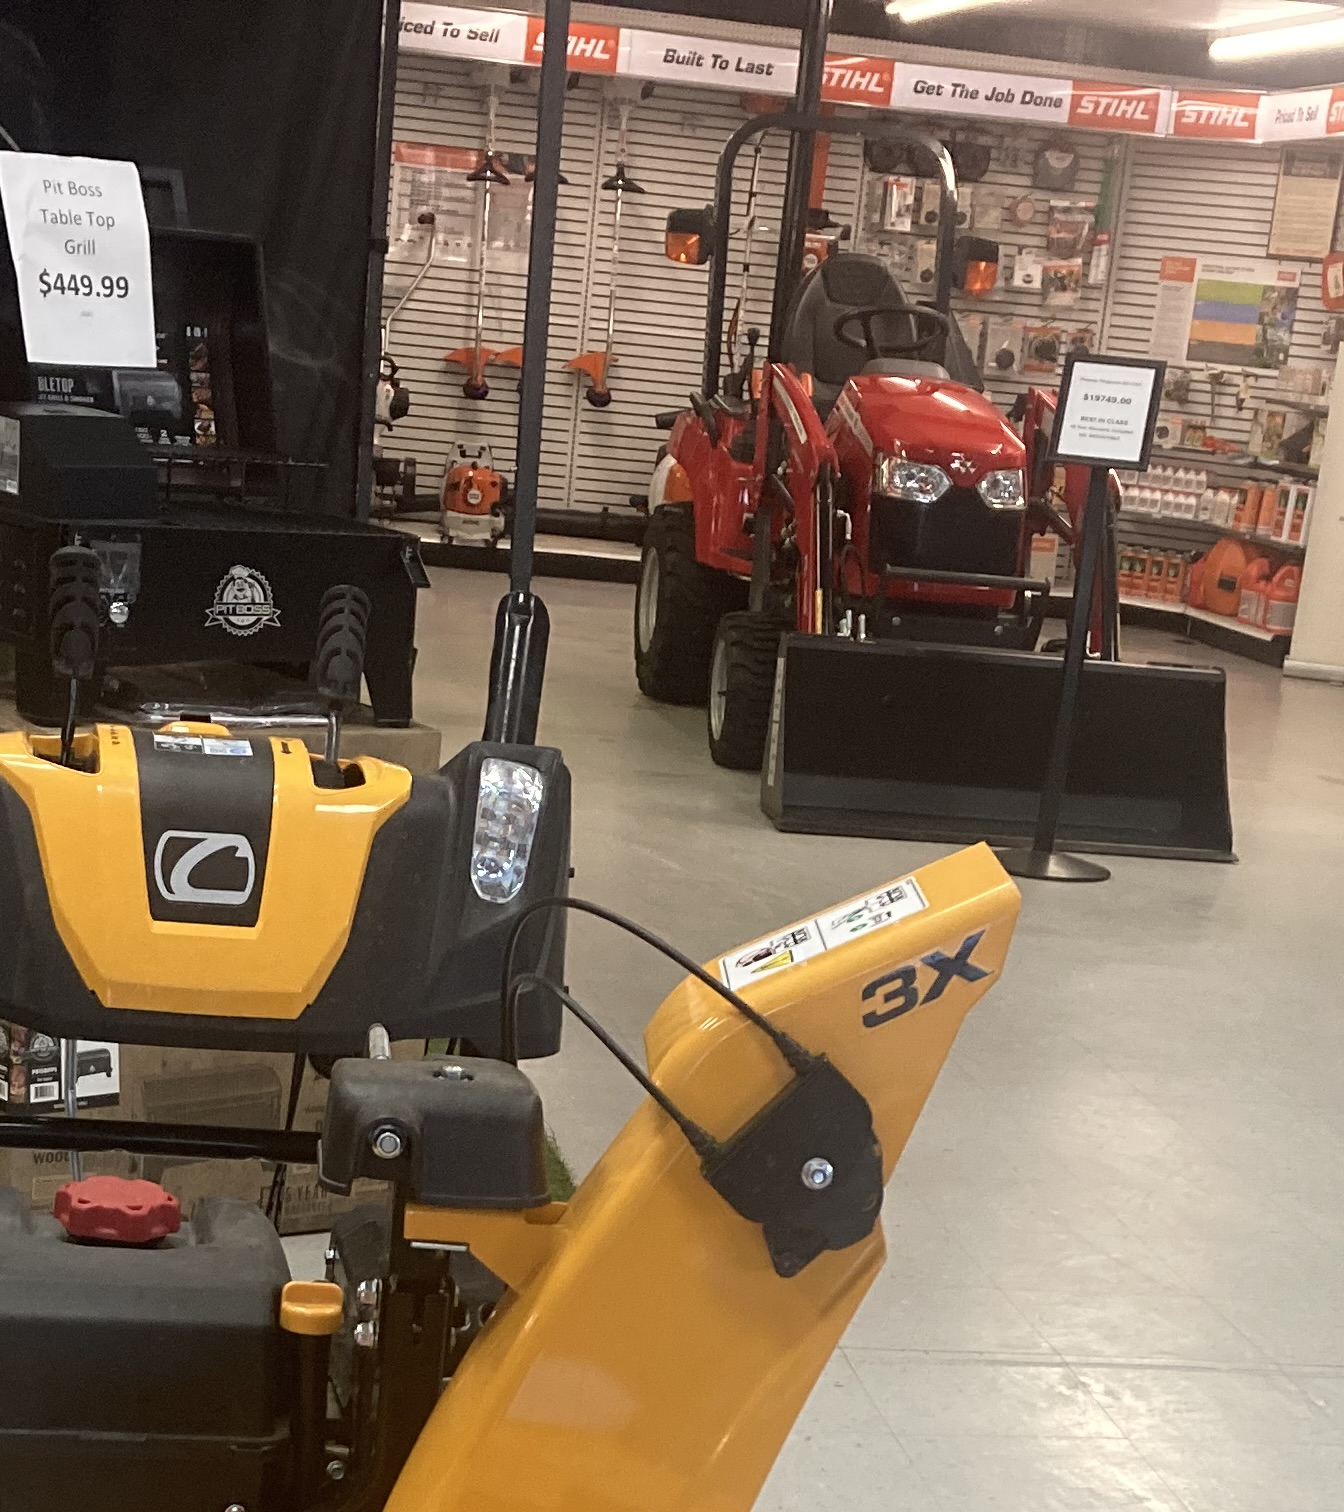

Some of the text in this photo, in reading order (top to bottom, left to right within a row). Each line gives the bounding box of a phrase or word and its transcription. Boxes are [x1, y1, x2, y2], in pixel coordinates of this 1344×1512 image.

[399, 17, 500, 44] iced To Sell
[662, 48, 775, 77] Built To Last
[913, 79, 1063, 109] Get The Job Done
[1076, 95, 1150, 120] STIHL
[1181, 107, 1251, 128] STIHL
[42, 179, 103, 198] Pit Boss
[40, 208, 116, 230] Table Top
[64, 238, 96, 256] Grill
[38, 267, 130, 299] $449.99
[38, 376, 74, 393] BLETOP
[216, 604, 271, 616] PIT BOSS
[861, 929, 994, 1029] 3X
